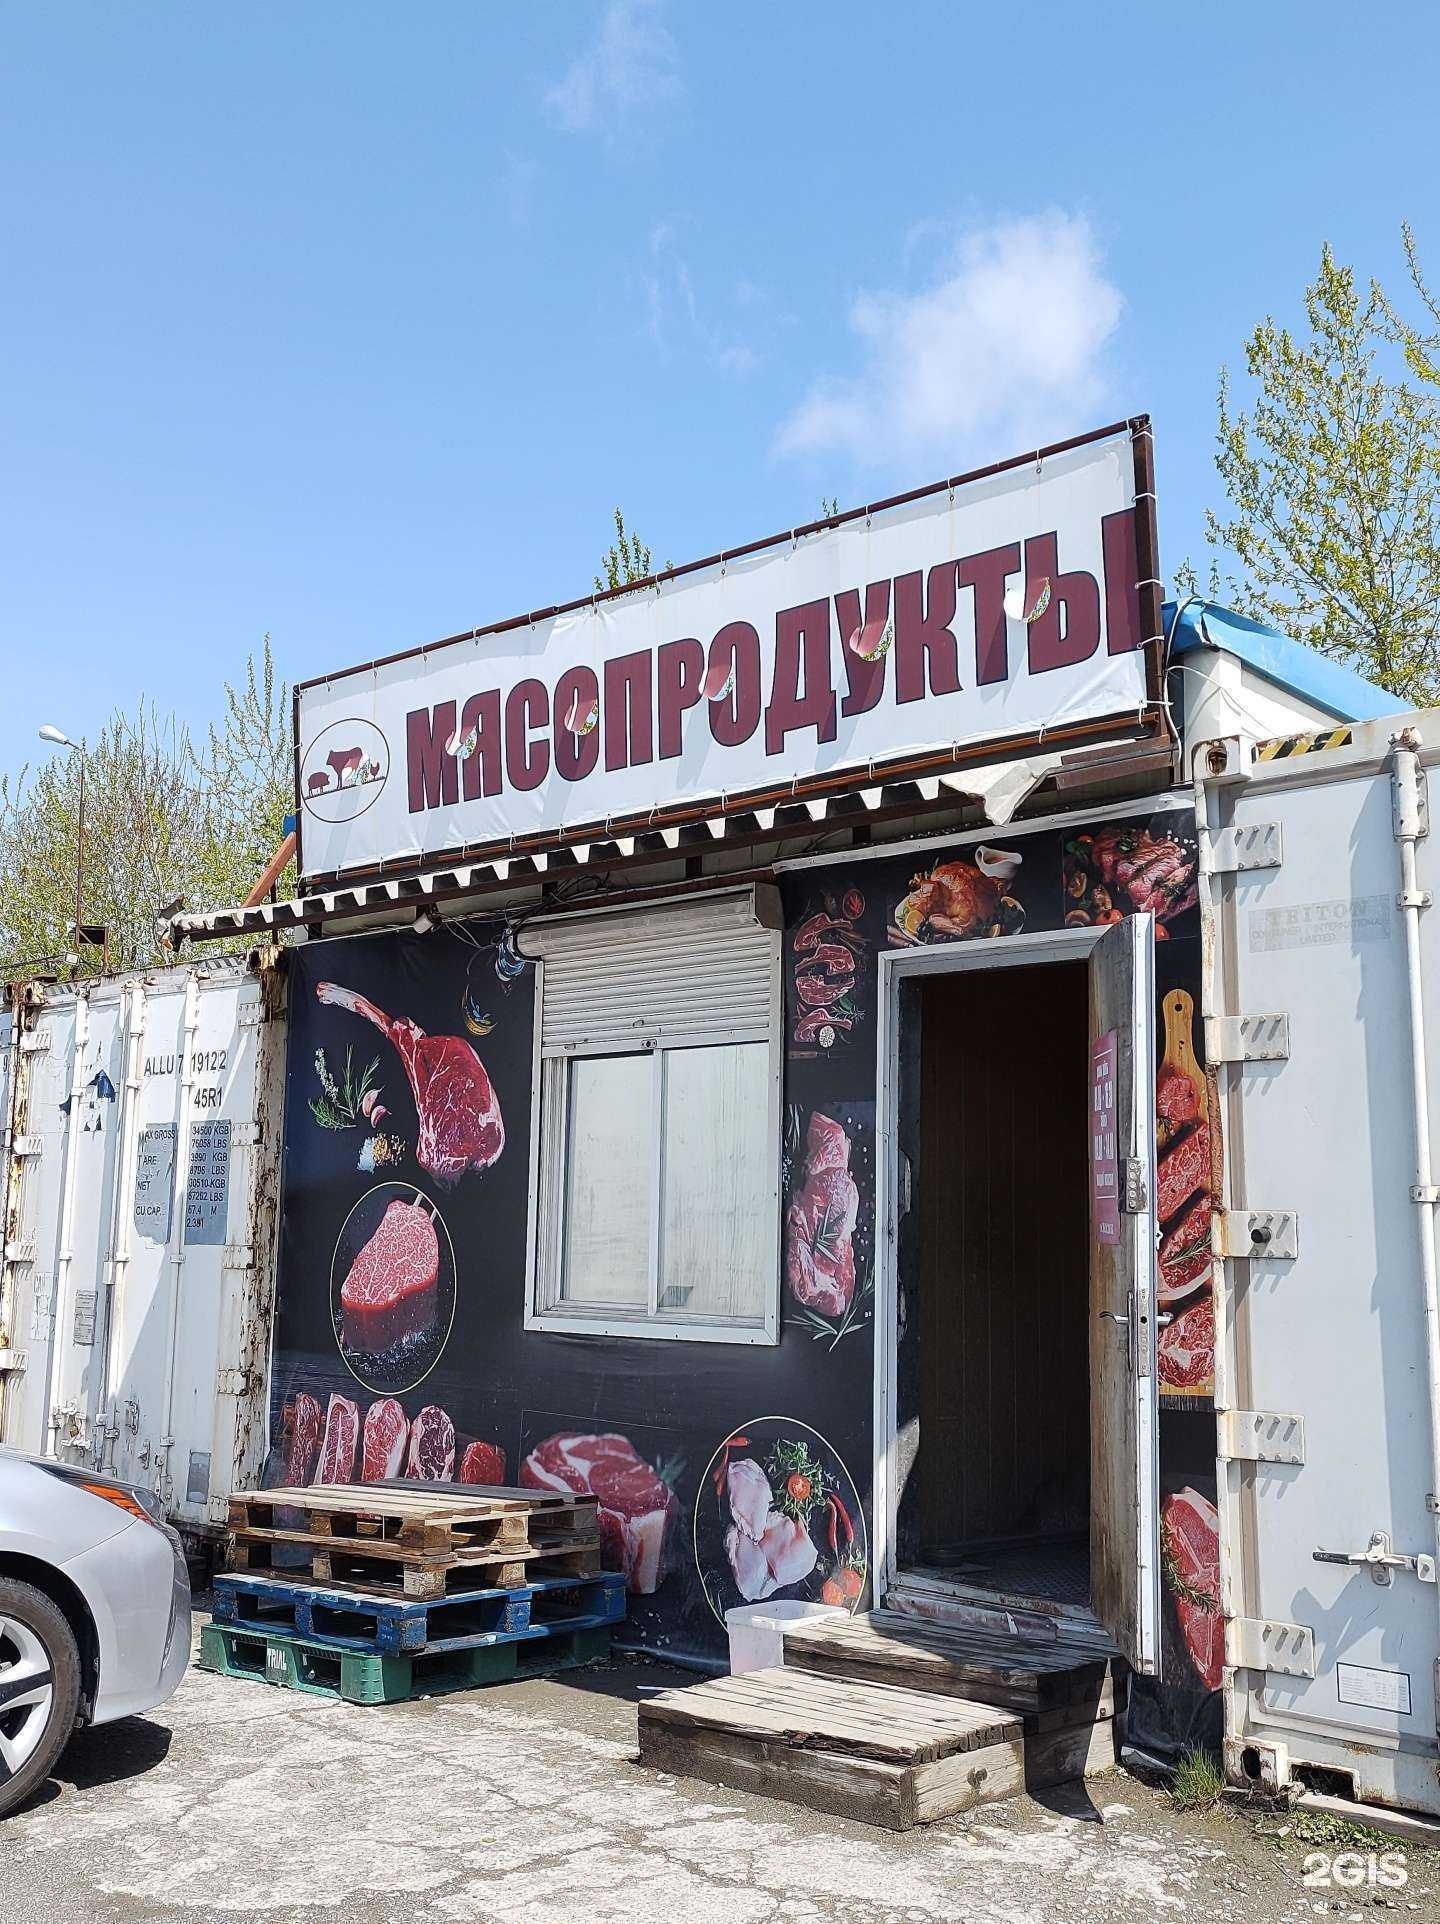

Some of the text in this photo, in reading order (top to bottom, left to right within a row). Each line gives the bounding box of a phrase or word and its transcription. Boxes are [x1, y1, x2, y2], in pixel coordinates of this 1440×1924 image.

[406, 507, 1145, 813] МЯСОПРОДУКТЫ
[144, 1055, 174, 1077] ALLU
[194, 1087, 222, 1108] 45R1
[214, 1138, 227, 1149] LBS
[212, 1165, 226, 1175] LBS
[136, 1181, 151, 1191] NET
[210, 1191, 224, 1202] LBS
[267, 1647, 287, 1670] TRIAL
